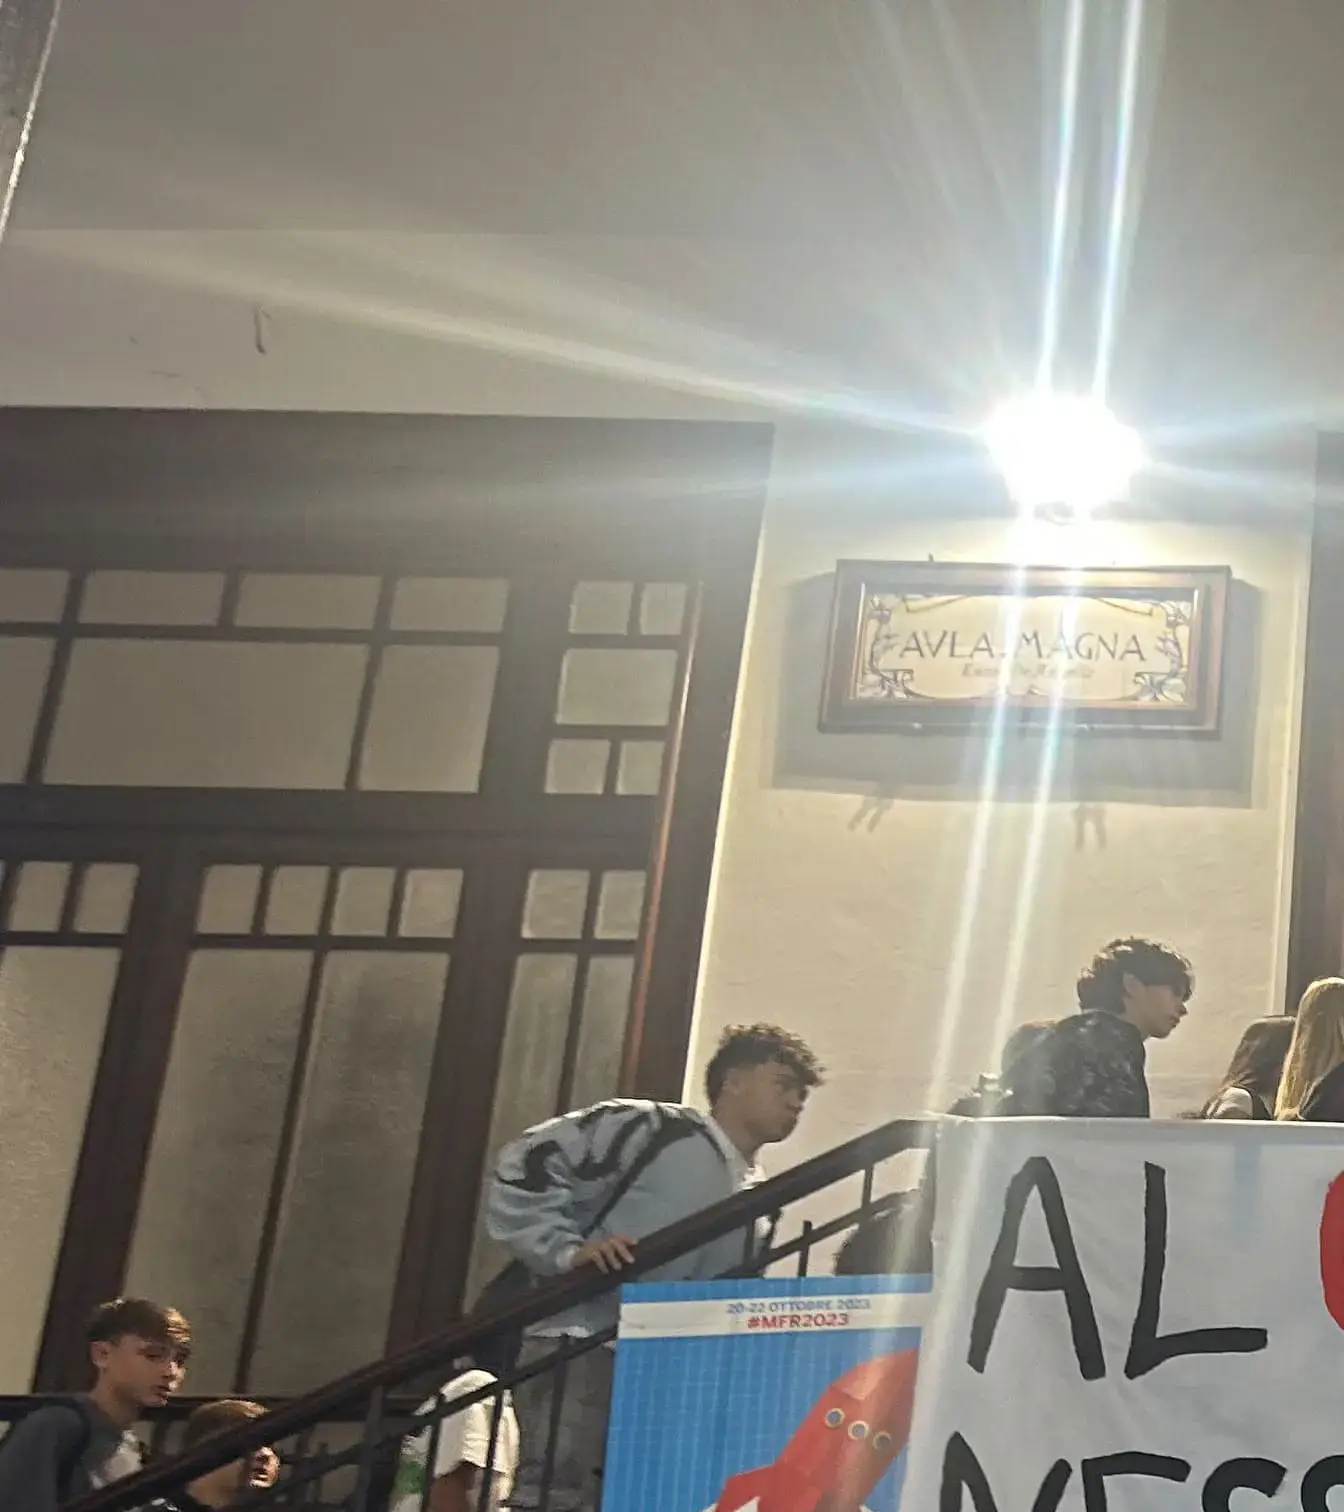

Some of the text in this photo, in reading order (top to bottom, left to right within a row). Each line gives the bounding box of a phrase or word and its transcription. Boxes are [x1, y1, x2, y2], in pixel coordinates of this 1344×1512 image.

[967, 1156, 1268, 1380] AL
[768, 1300, 832, 1313] OTTOBRE
[747, 1312, 850, 1329] #MFR2023
